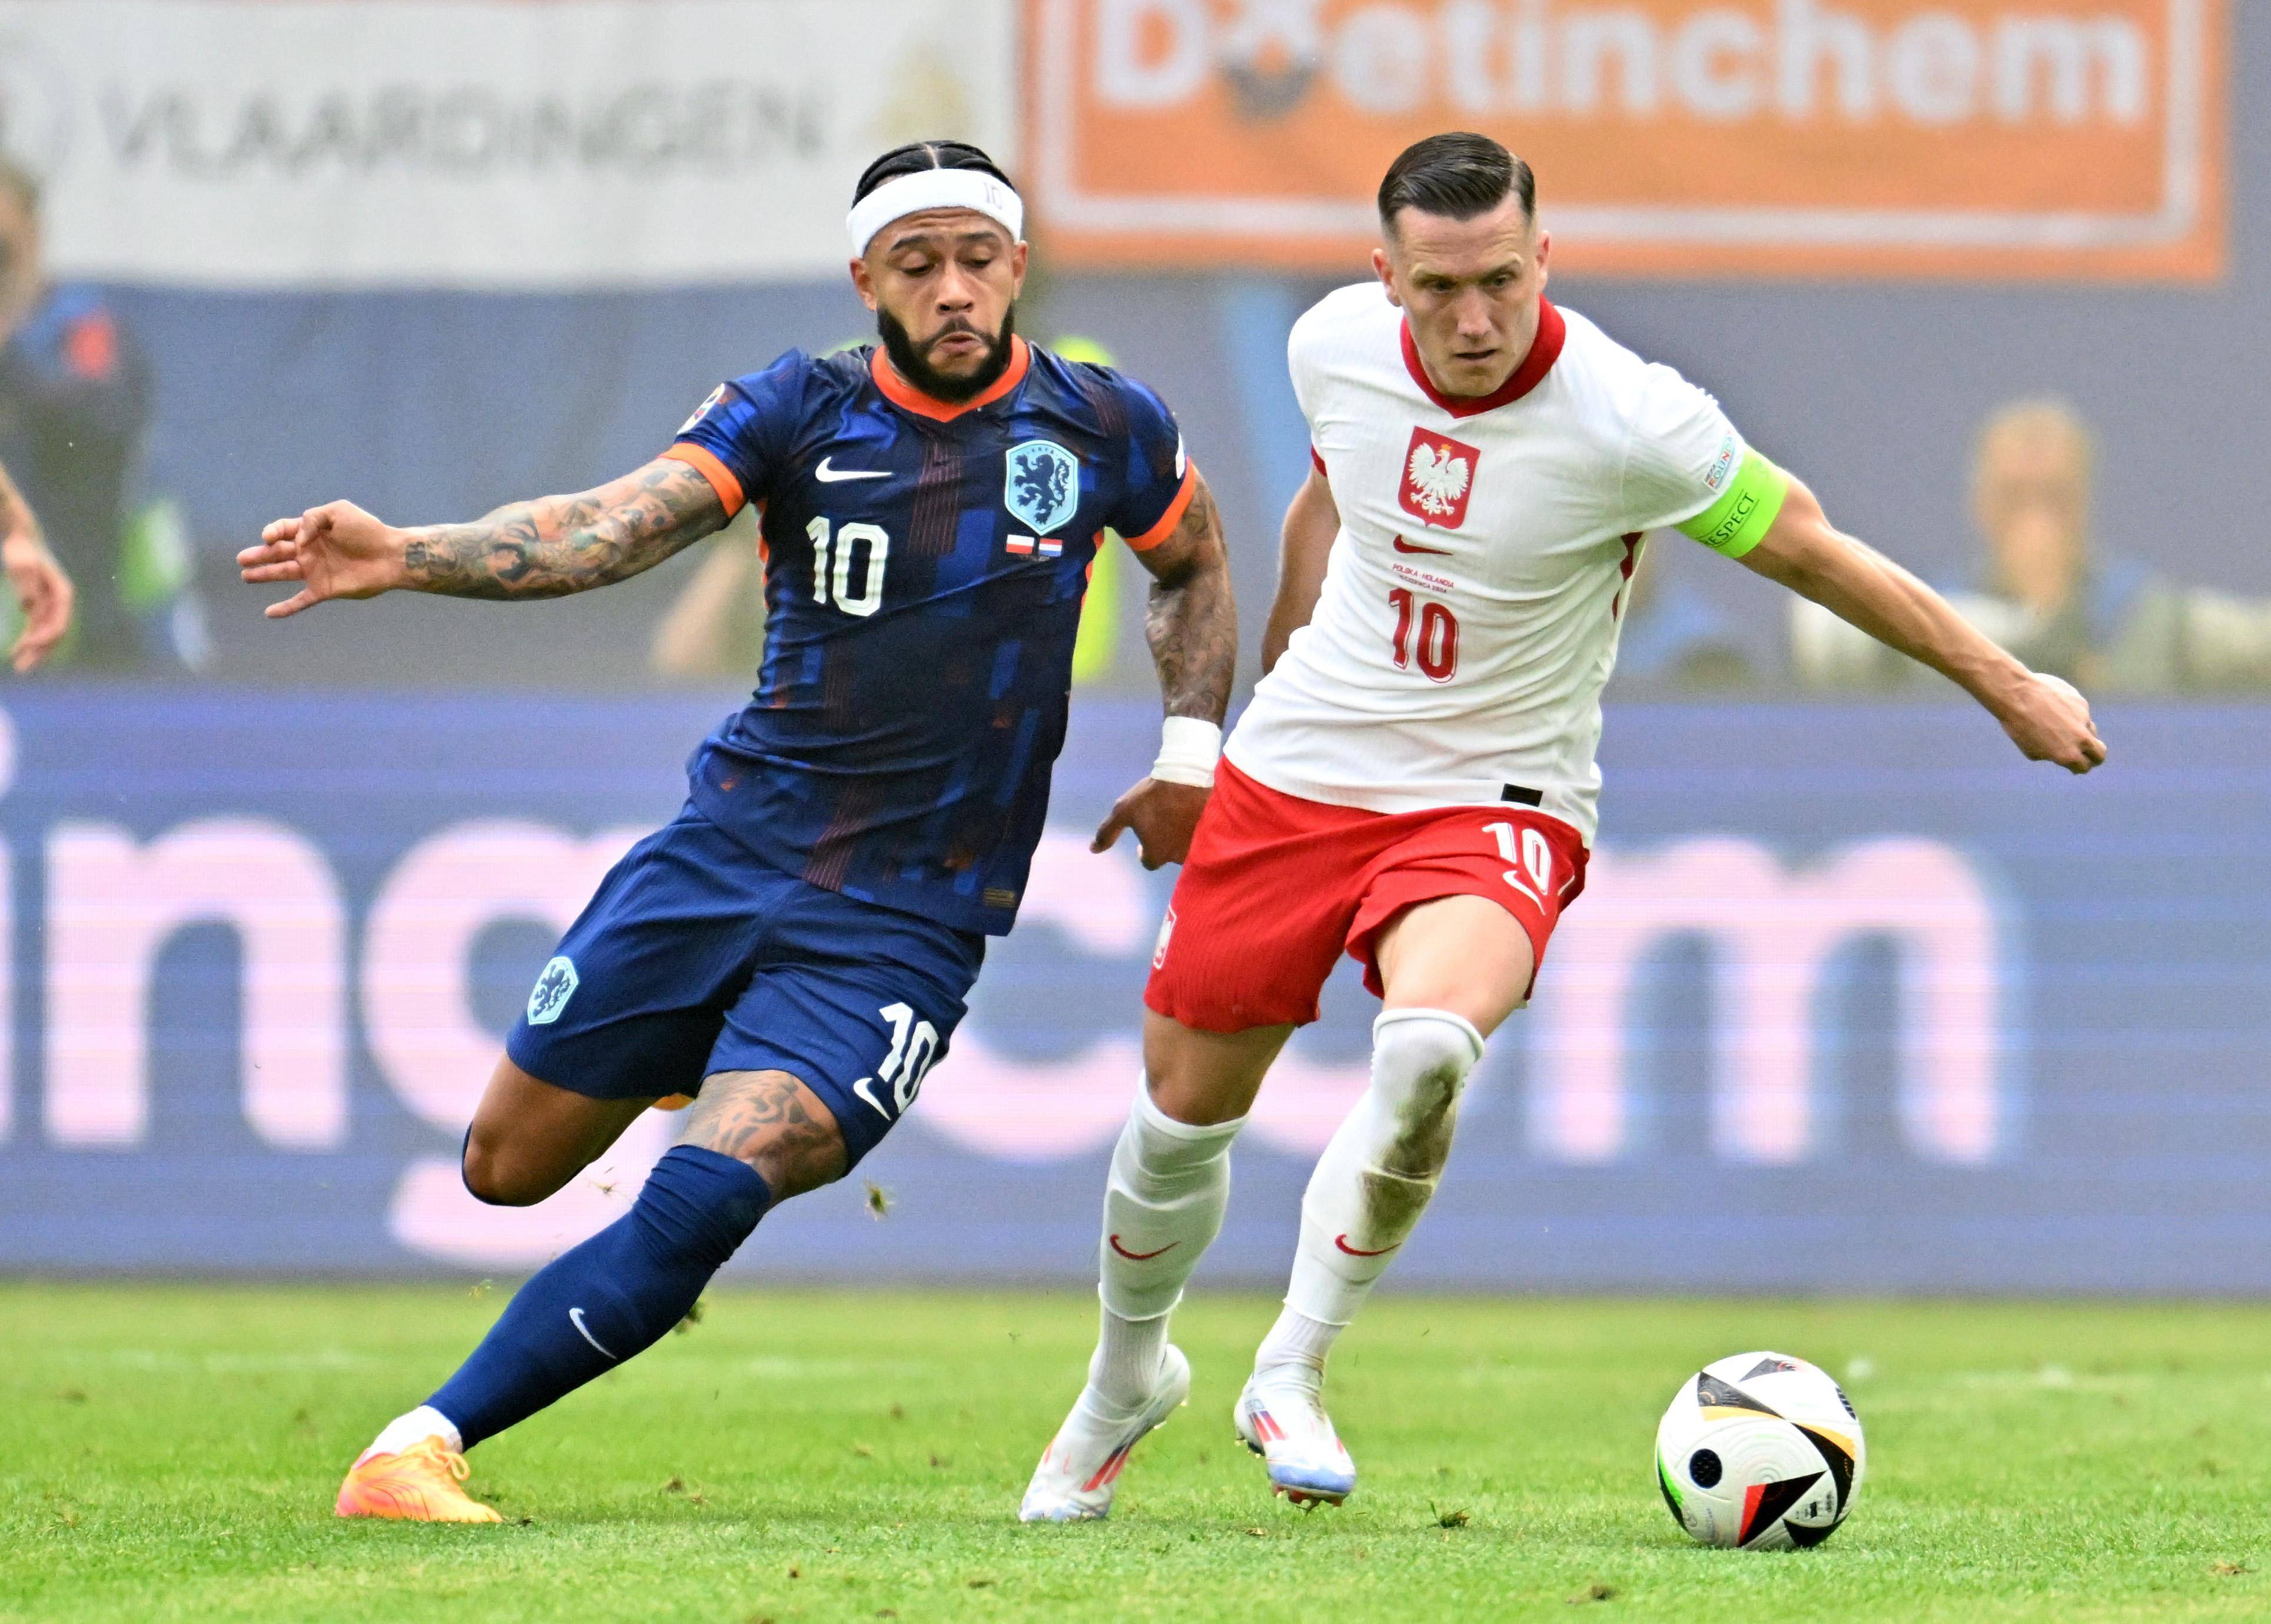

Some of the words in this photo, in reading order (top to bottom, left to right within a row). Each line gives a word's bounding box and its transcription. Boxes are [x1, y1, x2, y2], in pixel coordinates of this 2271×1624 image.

[806, 516, 889, 617] 10
[1388, 587, 1459, 683] 10
[1481, 822, 1552, 896] 10
[877, 1001, 939, 1114] 10
